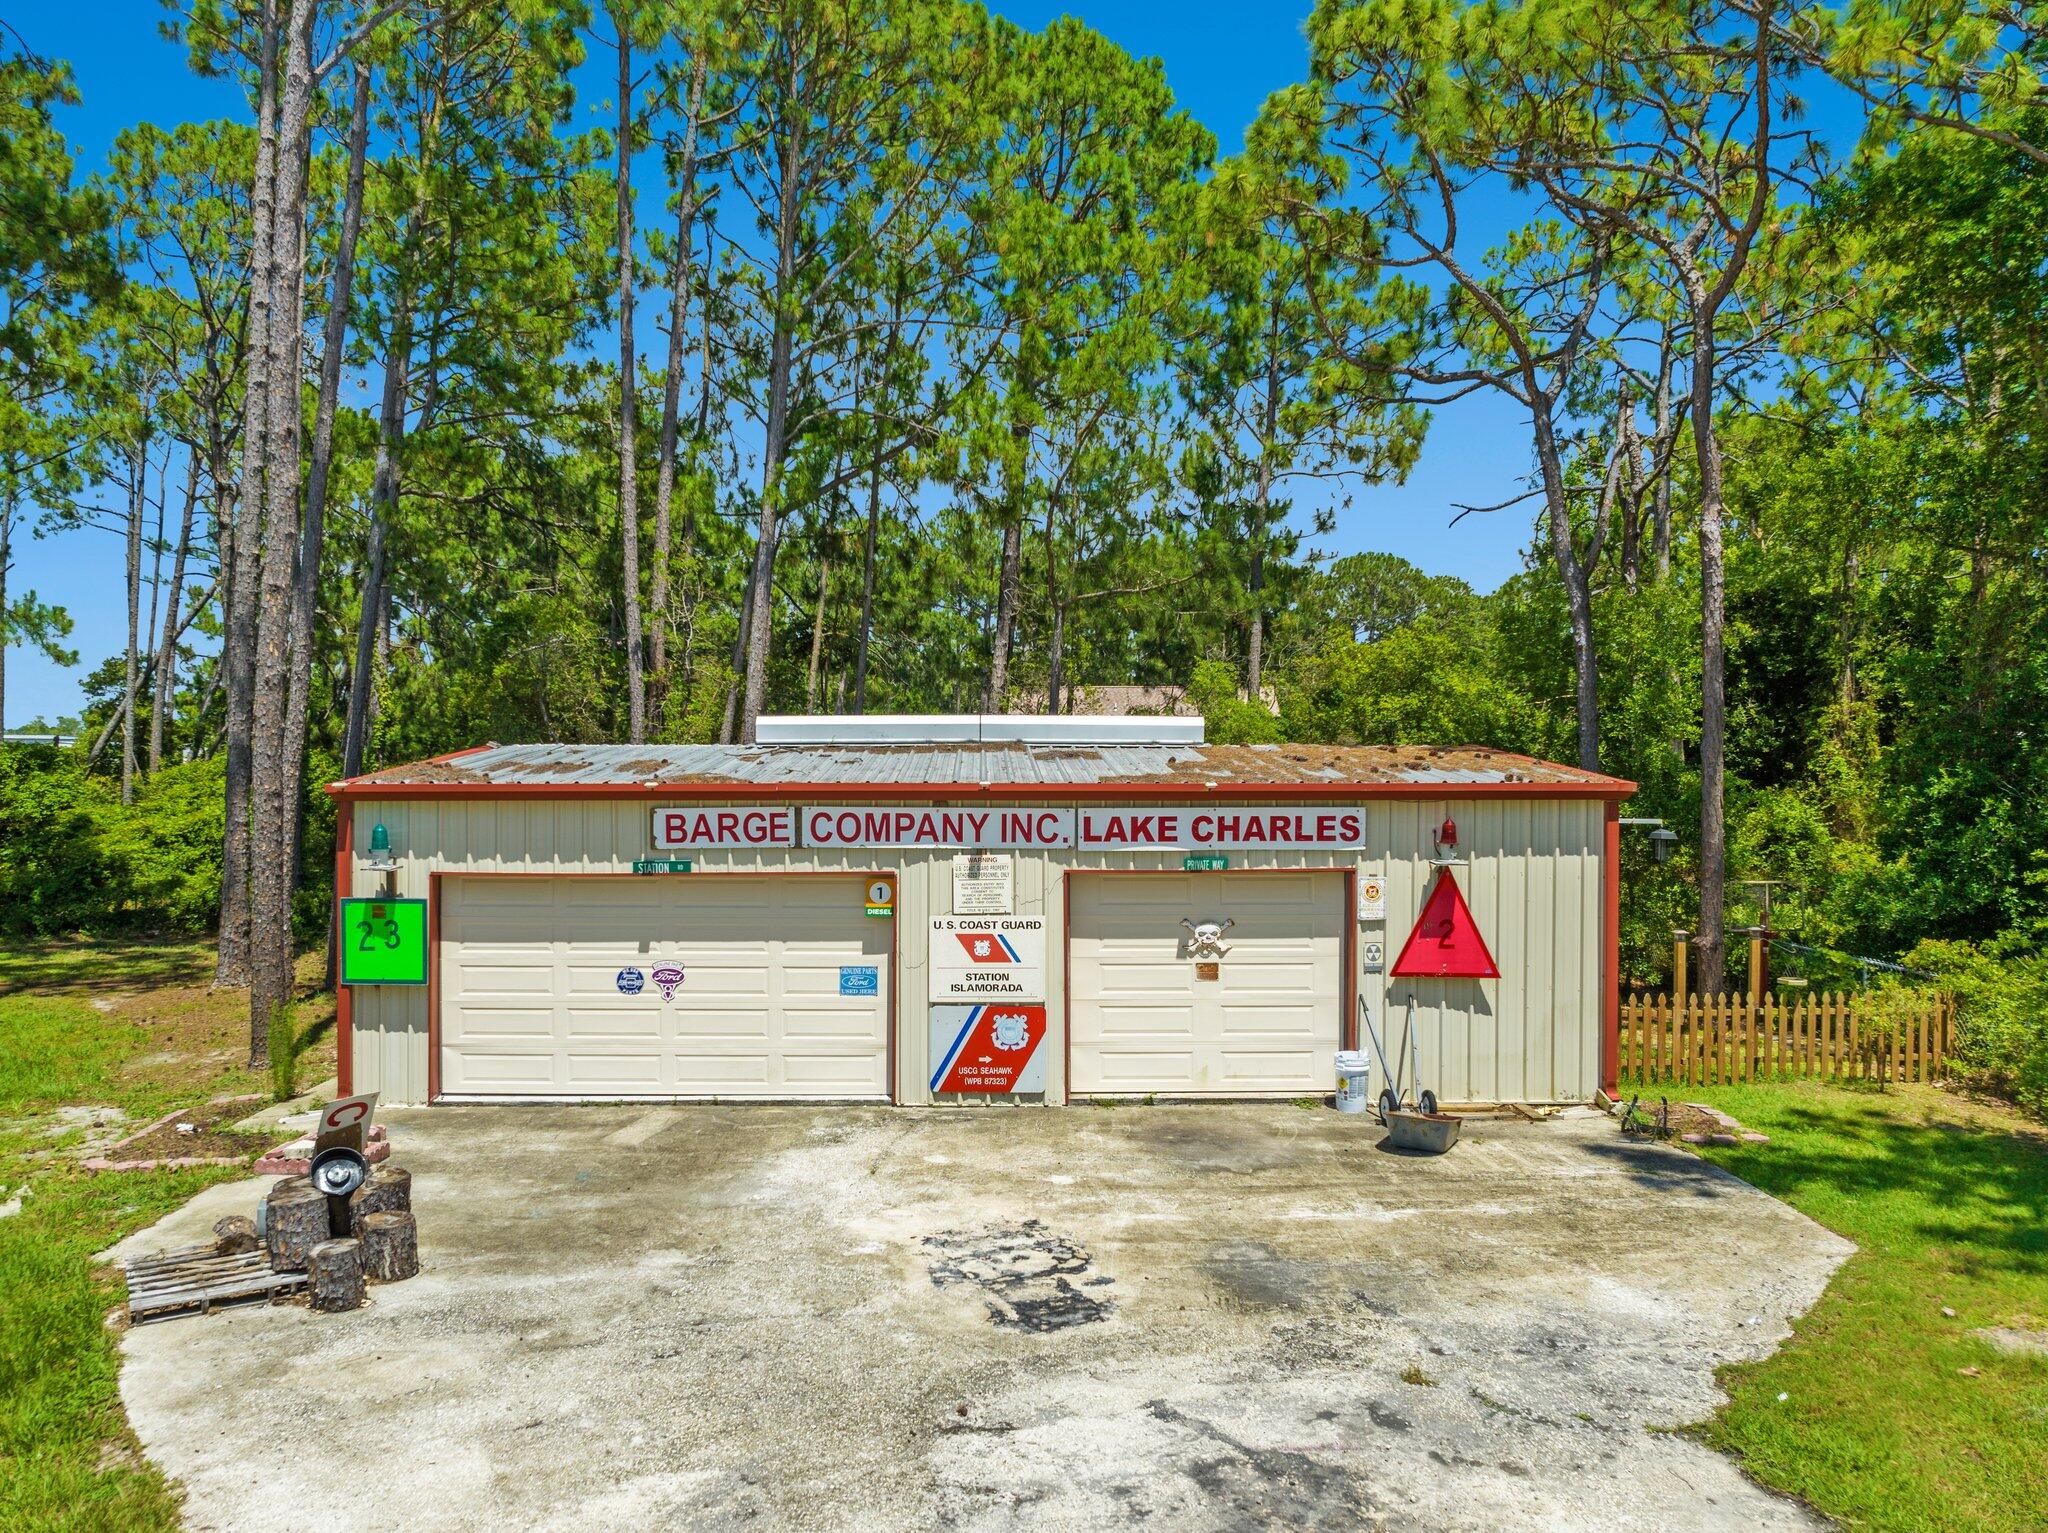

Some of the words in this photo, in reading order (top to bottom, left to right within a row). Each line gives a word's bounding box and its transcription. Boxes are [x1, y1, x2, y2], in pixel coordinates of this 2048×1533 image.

[665, 812, 790, 844] BARGE
[810, 812, 990, 843] COMPANY
[1001, 812, 1069, 844] INC.
[1083, 816, 1178, 842] LAKE
[1192, 814, 1361, 842] CHARLES
[638, 862, 670, 873] STATION
[1187, 860, 1210, 870] PRIVATE
[1212, 860, 1224, 870] WAY
[877, 887, 882, 899] 1
[960, 921, 998, 929] COAST
[1002, 921, 1041, 929] GUARD
[1438, 919, 1455, 949] 2
[654, 971, 683, 981] Ford
[848, 976, 870, 986] Ford
[965, 1077, 984, 1085] (WPB
[984, 1077, 1007, 1085] 87323)
